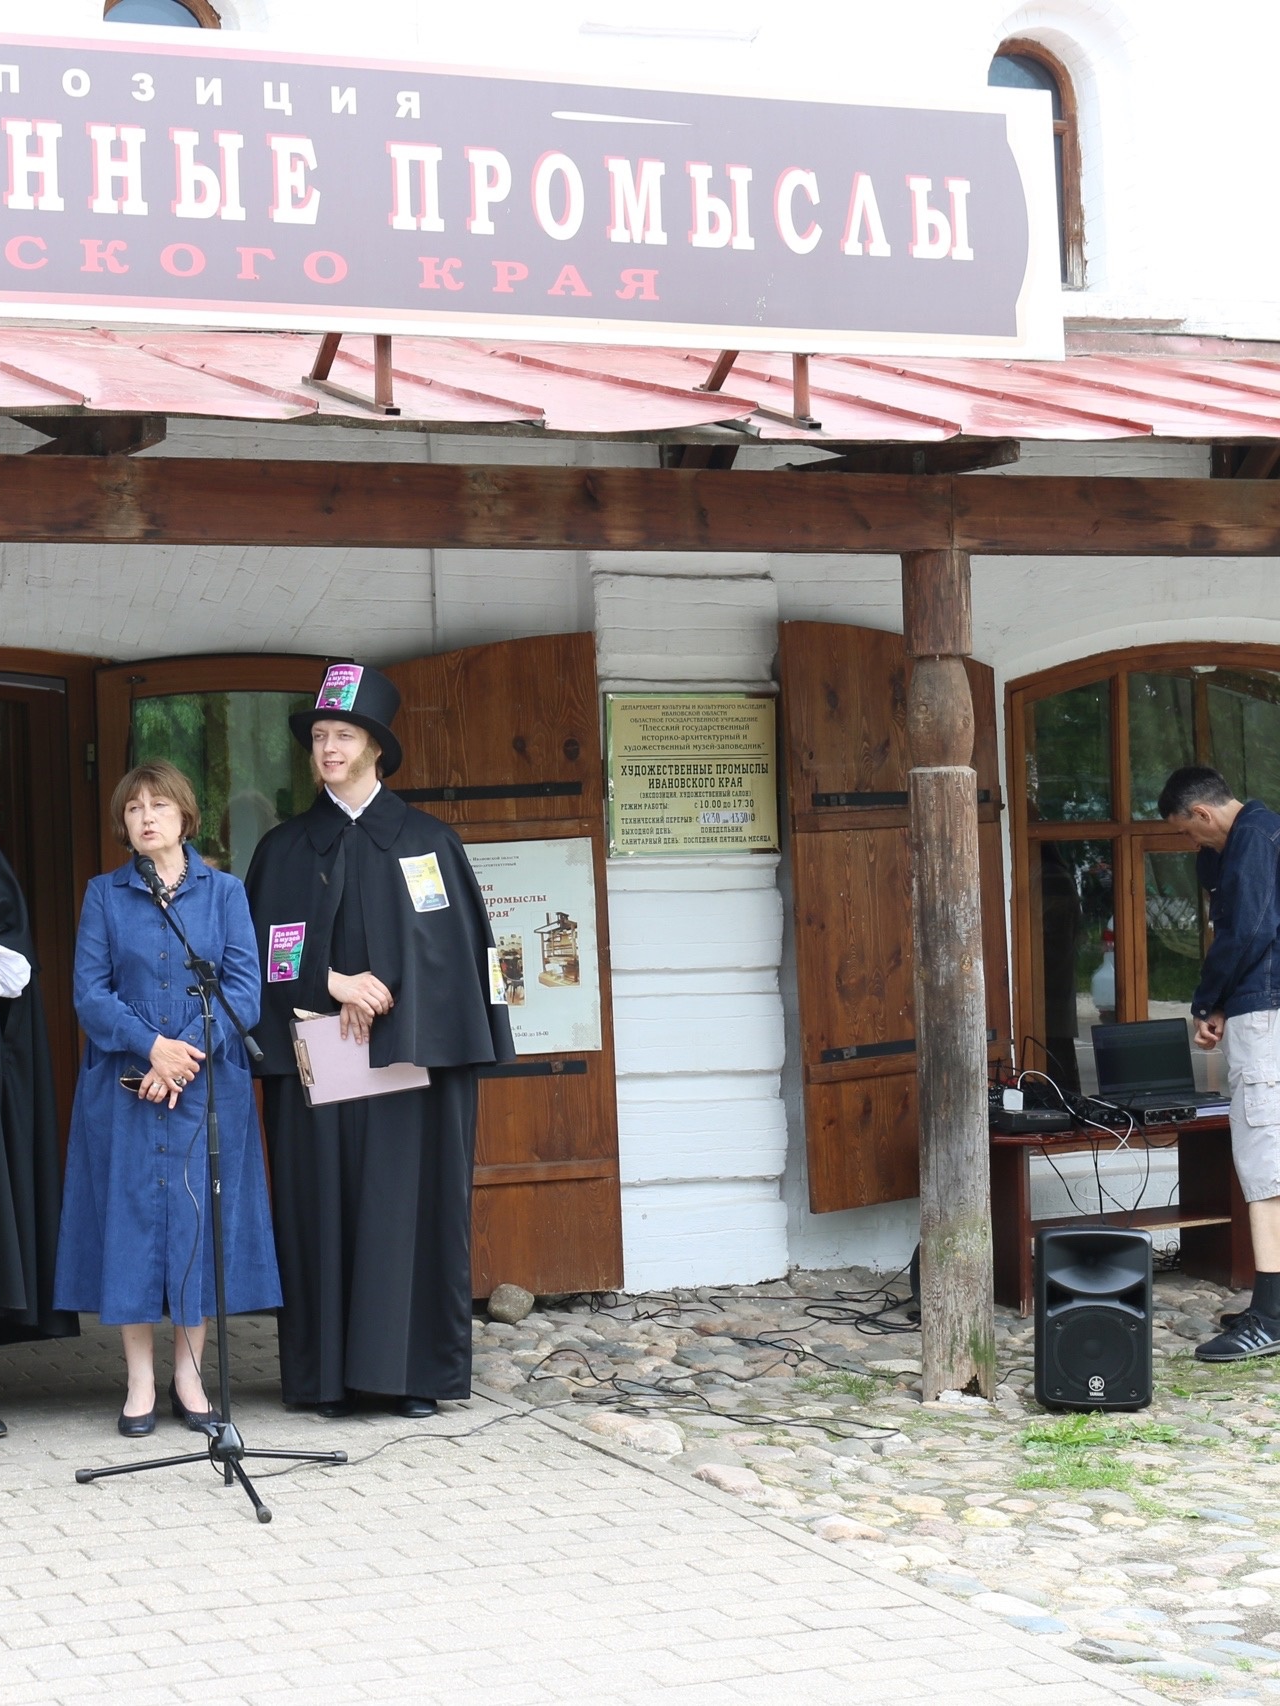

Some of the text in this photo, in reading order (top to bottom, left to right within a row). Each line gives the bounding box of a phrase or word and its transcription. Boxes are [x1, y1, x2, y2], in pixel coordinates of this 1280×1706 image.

[386, 141, 974, 261] ПРОМЫСЛЫ
[419, 257, 660, 301] КРАЯ
[682, 723, 750, 733] государственный
[641, 733, 740, 743] историко-архитектурный
[623, 742, 691, 752] художественный
[621, 763, 769, 777] ХУДОЖЕСТВЕННЫЕ ПРОМЫСЛЫ
[648, 777, 743, 789] ИВАНОВСКОГО КРАЯ
[679, 789, 731, 798] ХУДОЖЕСТВЕННЫЙ
[620, 803, 643, 811] РЕЖИМ
[700, 799, 722, 809] 10.00
[733, 798, 755, 808] 17.30
[621, 816, 665, 825] ТЕХНИЧЕСКИЙ
[621, 826, 654, 836] ВЫХОДНОЙ
[700, 825, 744, 834] ПОНЕДЕЛЬНИК
[621, 836, 662, 846] САНИТАРНЫЙ
[683, 836, 718, 844] ПОСЛЕДНЯЯ
[719, 835, 747, 843] ПЯТНИЦА
[488, 906, 516, 921] рая"
[274, 941, 293, 949] пора!
